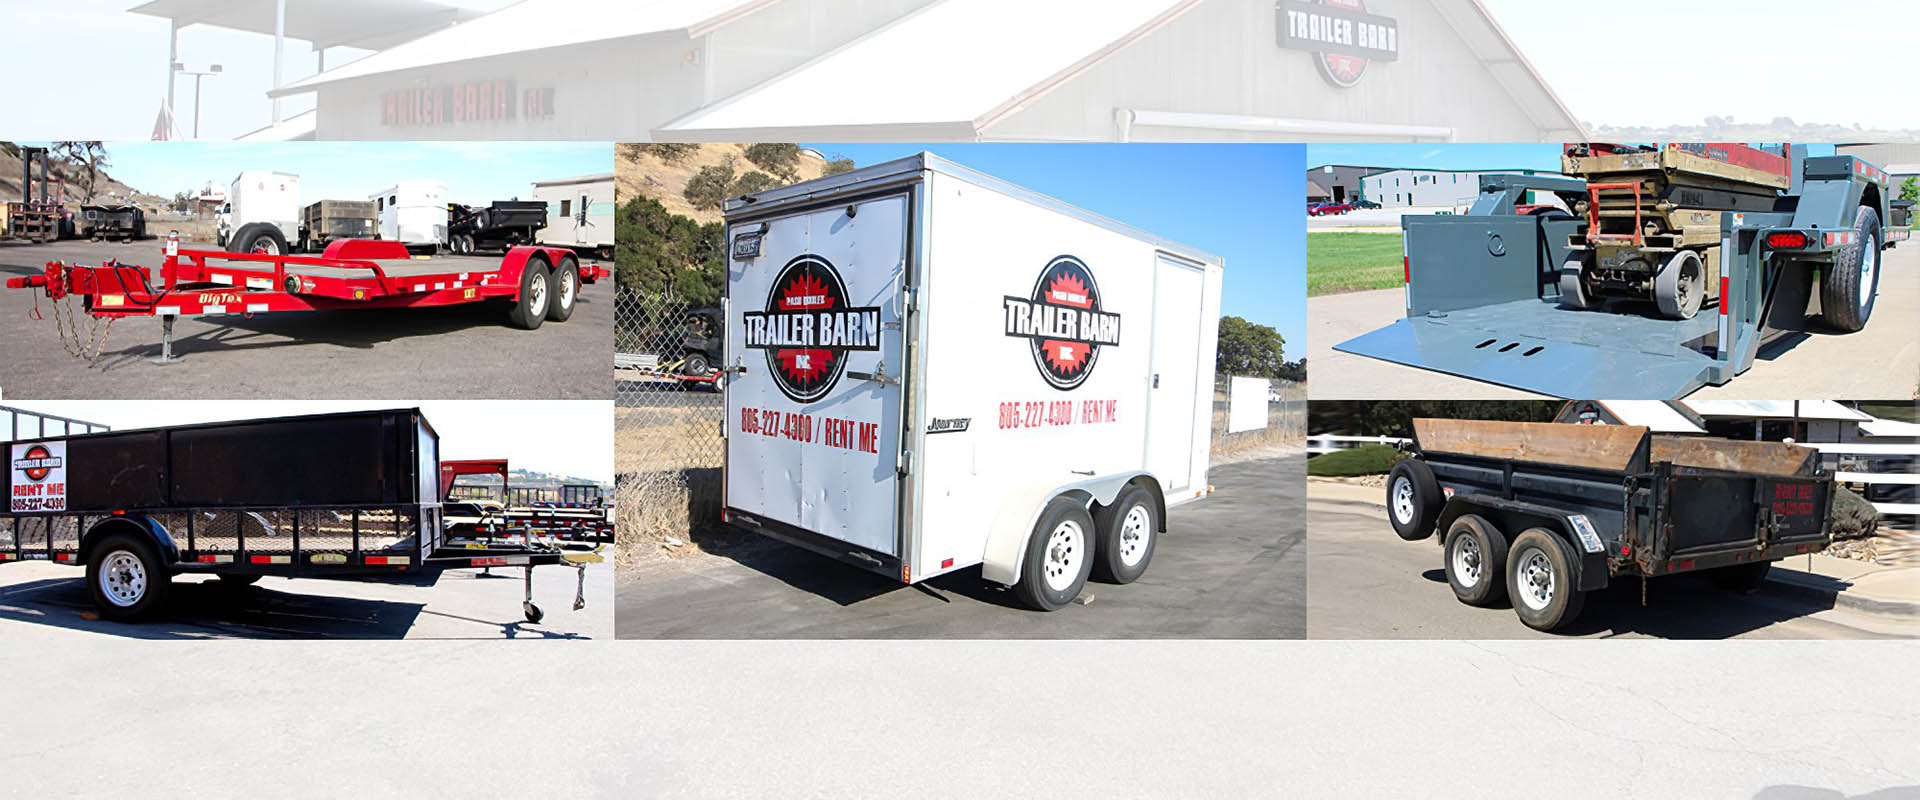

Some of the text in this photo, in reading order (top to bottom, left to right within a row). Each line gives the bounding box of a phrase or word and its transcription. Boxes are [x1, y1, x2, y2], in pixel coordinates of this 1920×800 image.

[1287, 9, 1397, 52] TRAILER BARN
[745, 311, 878, 347] TRAILER BARN
[1005, 299, 1120, 344] TRAILER BARN
[1081, 400, 1104, 425] RENT
[1105, 399, 1118, 423] ME
[824, 417, 855, 450] RENT
[858, 421, 878, 454] ME
[13, 483, 65, 496] RENT ME
